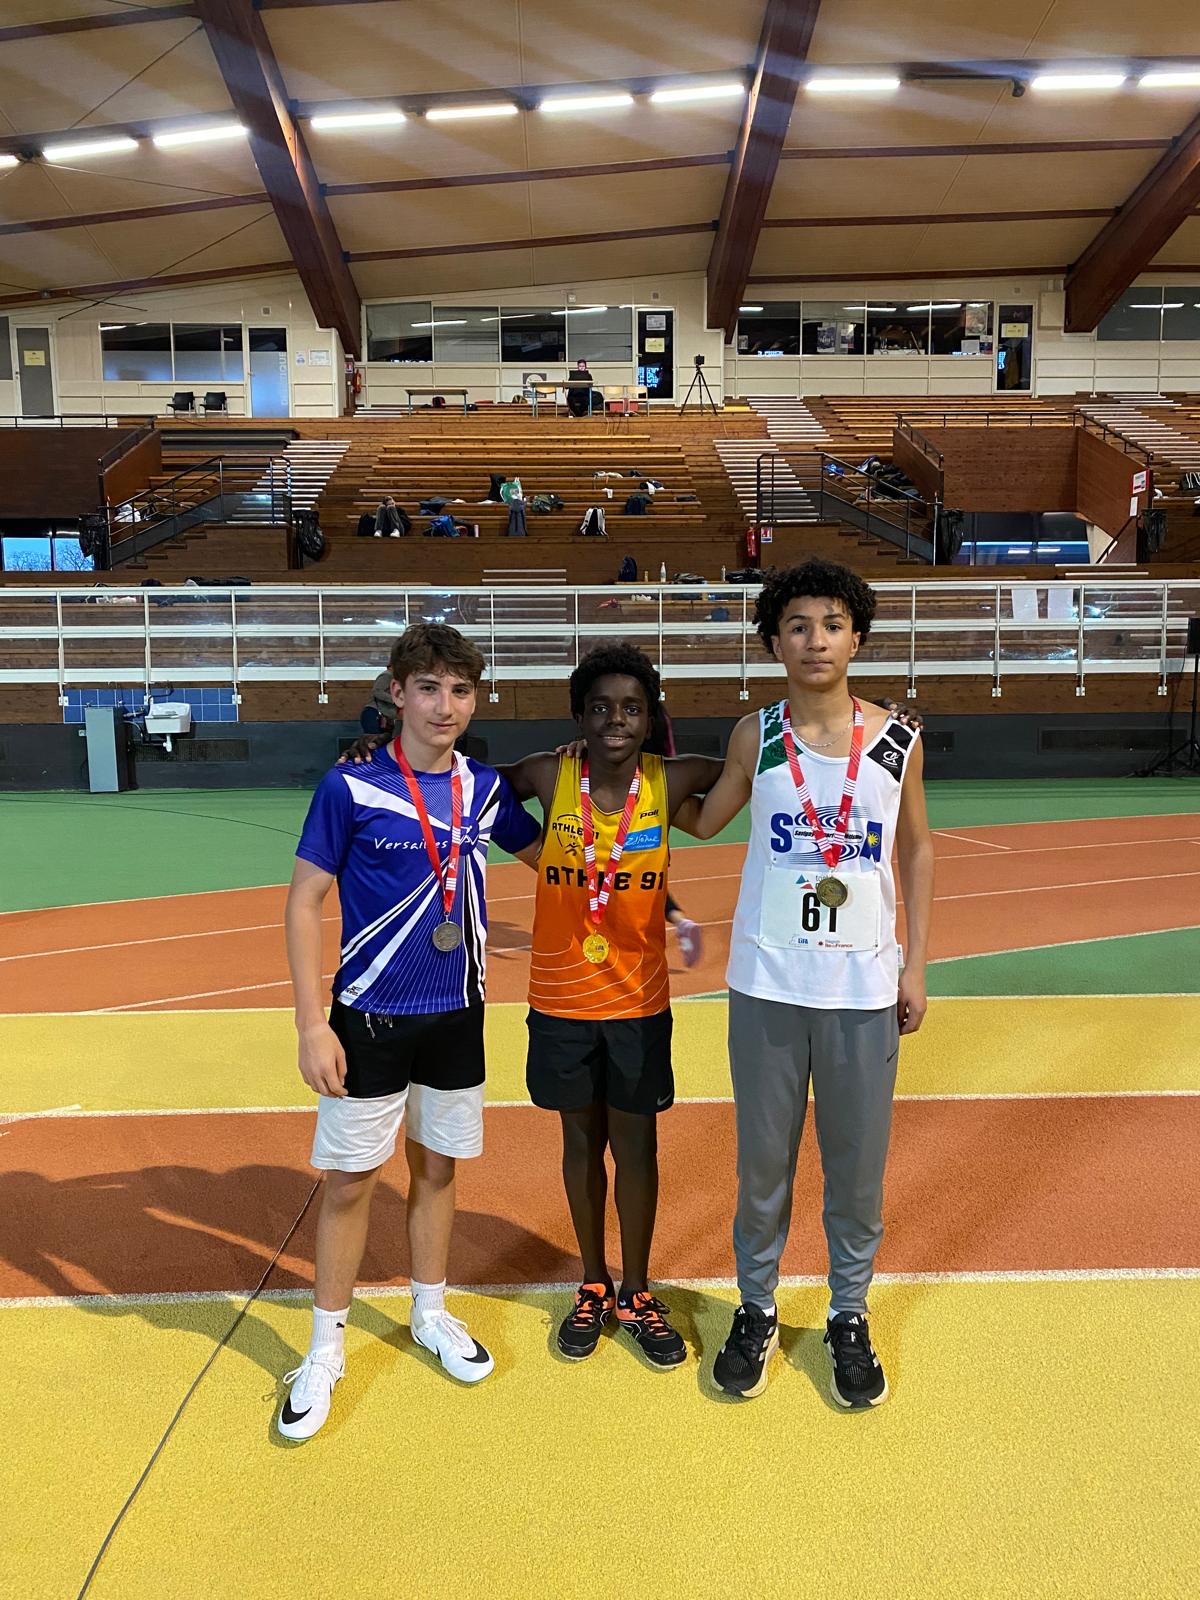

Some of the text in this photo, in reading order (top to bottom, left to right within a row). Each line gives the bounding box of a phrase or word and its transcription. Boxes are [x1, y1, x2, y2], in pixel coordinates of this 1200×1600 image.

[374, 837, 449, 850] Versailes
[640, 871, 664, 890] 91
[802, 892, 837, 933] 61
